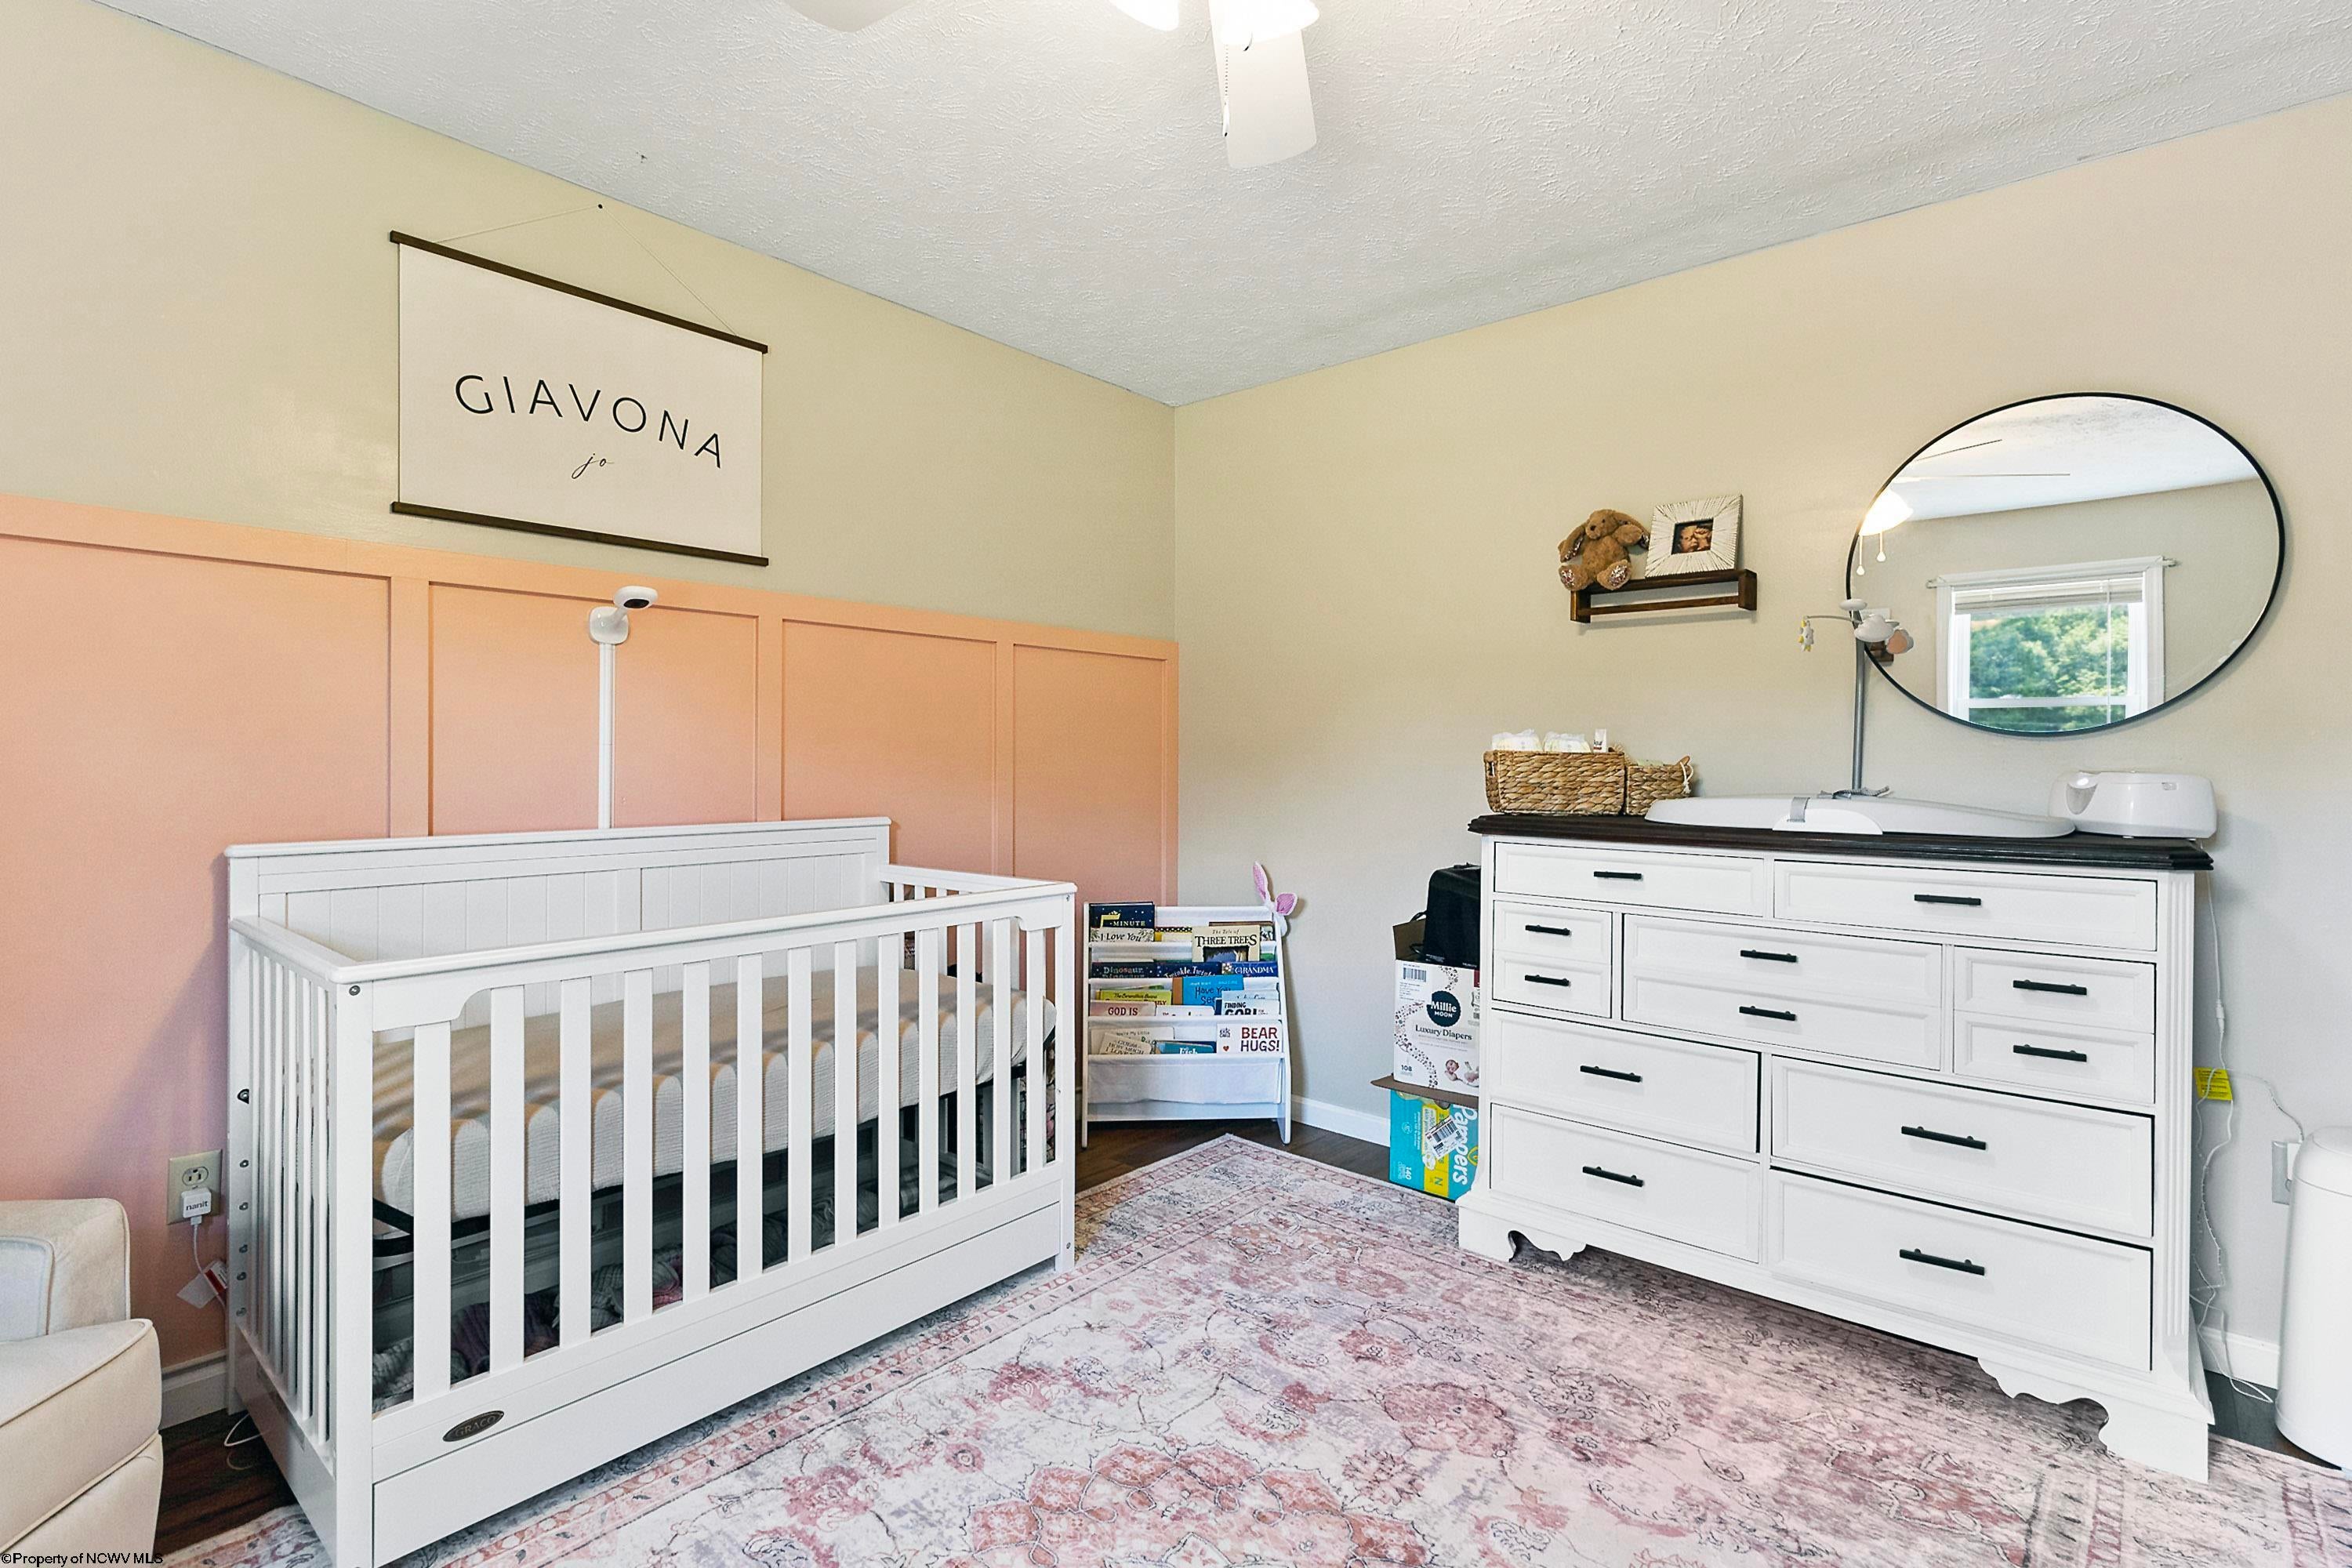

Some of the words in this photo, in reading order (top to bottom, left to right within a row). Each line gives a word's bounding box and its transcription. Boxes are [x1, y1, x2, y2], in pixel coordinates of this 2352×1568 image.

[455, 374, 721, 469] GIAVONA
[572, 452, 615, 479] jo
[1127, 933, 1142, 942] You
[1195, 936, 1226, 947] THREE
[1228, 935, 1258, 946] TREES
[1196, 986, 1214, 999] Have
[1108, 1007, 1127, 1016] GOD
[1129, 1007, 1138, 1016] IS
[1431, 1001, 1457, 1013] Millie
[1241, 1026, 1278, 1040] BEAR
[1415, 1024, 1442, 1036] Luxury
[1443, 1029, 1472, 1040] Diapers
[1240, 1040, 1280, 1052] HUGS!
[1452, 1104, 1478, 1185] Pampers
[186, 1200, 209, 1211] nanit
[455, 1415, 496, 1437] GRACO
